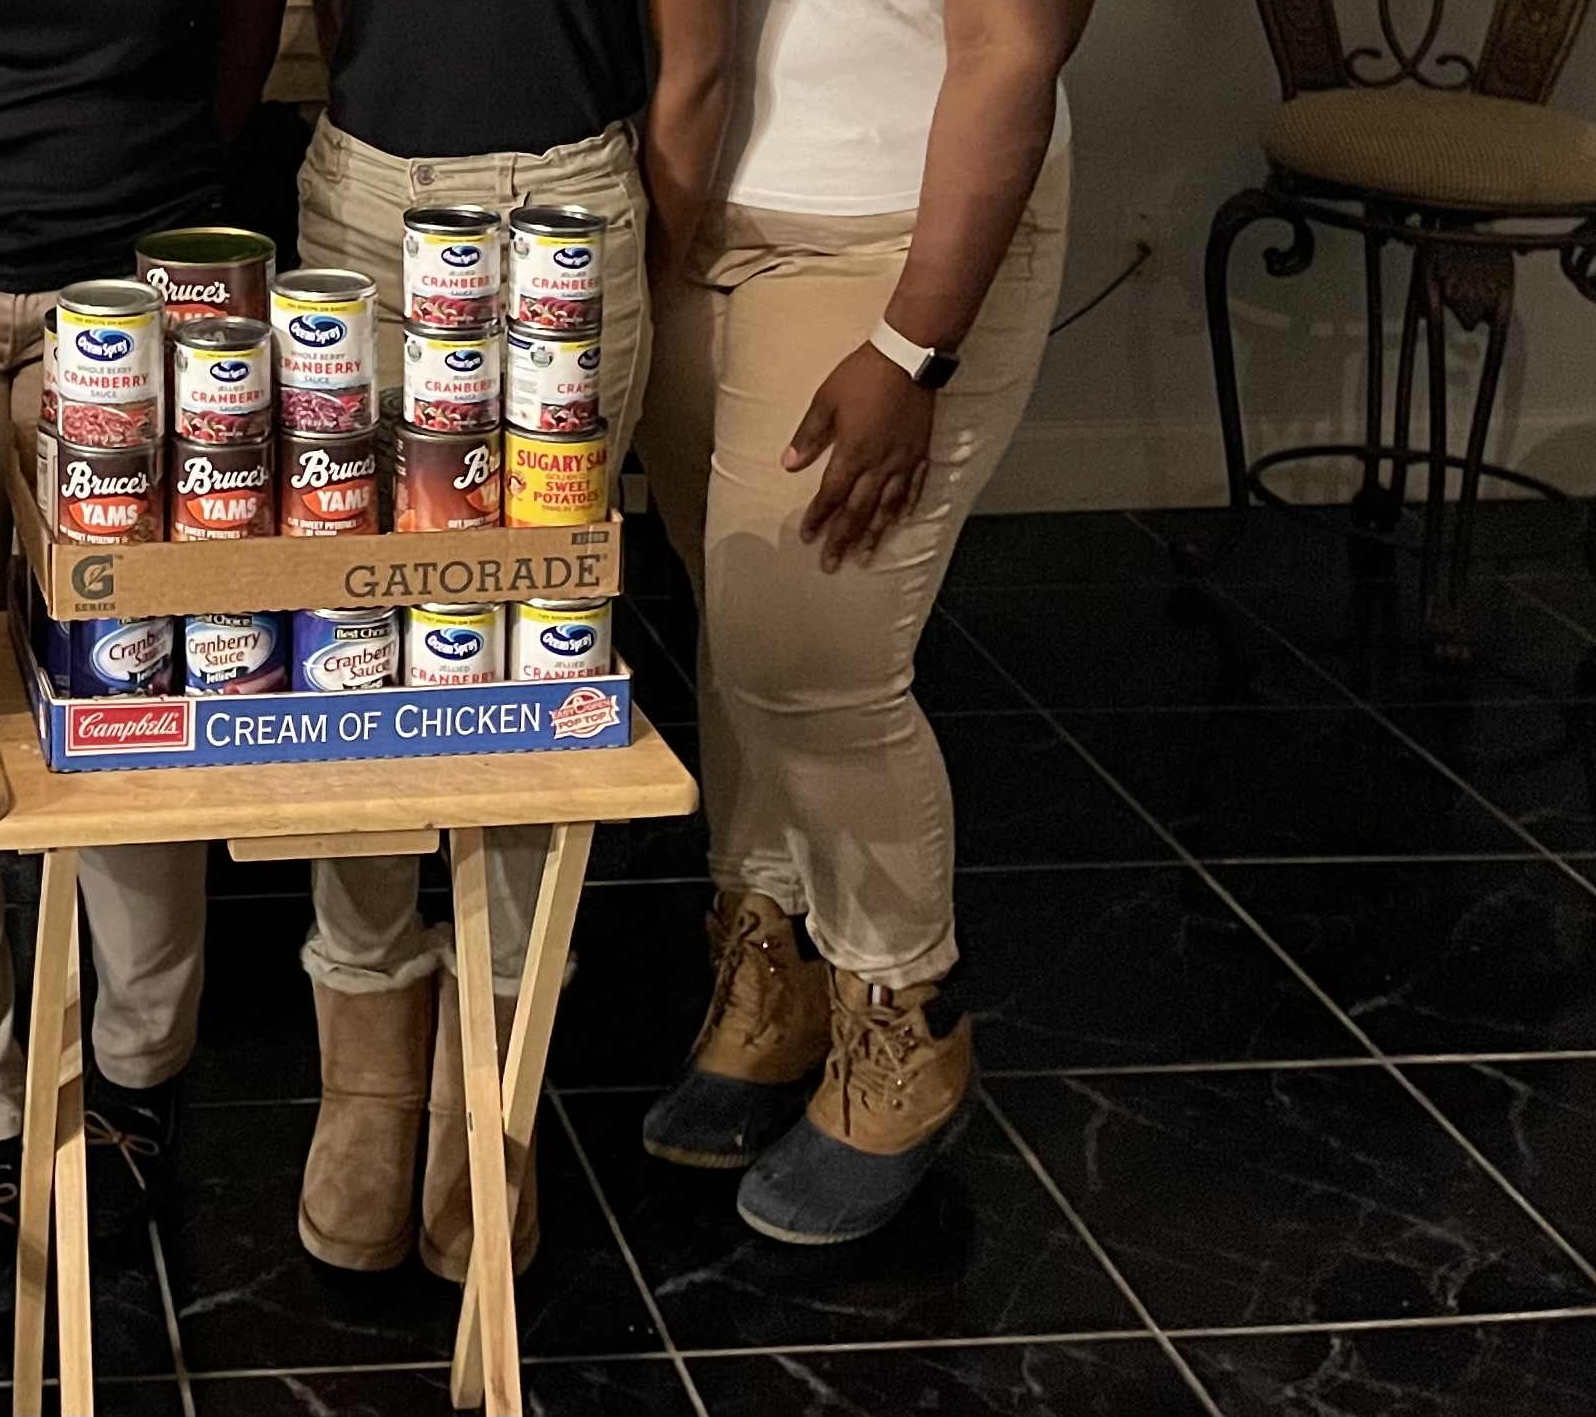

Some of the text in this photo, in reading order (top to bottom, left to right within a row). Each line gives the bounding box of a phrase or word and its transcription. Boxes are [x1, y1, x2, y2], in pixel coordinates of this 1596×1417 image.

[147, 268, 231, 304] Bruce's
[64, 370, 149, 389] CRANBERRY
[517, 450, 585, 473] SUGARY
[61, 461, 150, 499] Bruce's
[177, 457, 269, 495] Bruce's
[546, 480, 591, 492] SWEET
[199, 497, 257, 521] YAMS
[317, 486, 370, 512] YAMS
[533, 491, 599, 504] POTATOES
[80, 502, 139, 527] YAMS
[345, 554, 601, 598] GATORADE
[75, 603, 116, 612] SERIES
[189, 631, 261, 654] Cranberry
[205, 650, 245, 667] Sauce
[78, 712, 182, 742] Campbell's
[206, 702, 541, 747] CREAM OF CHICKEN
[558, 711, 607, 729] POP TOP
